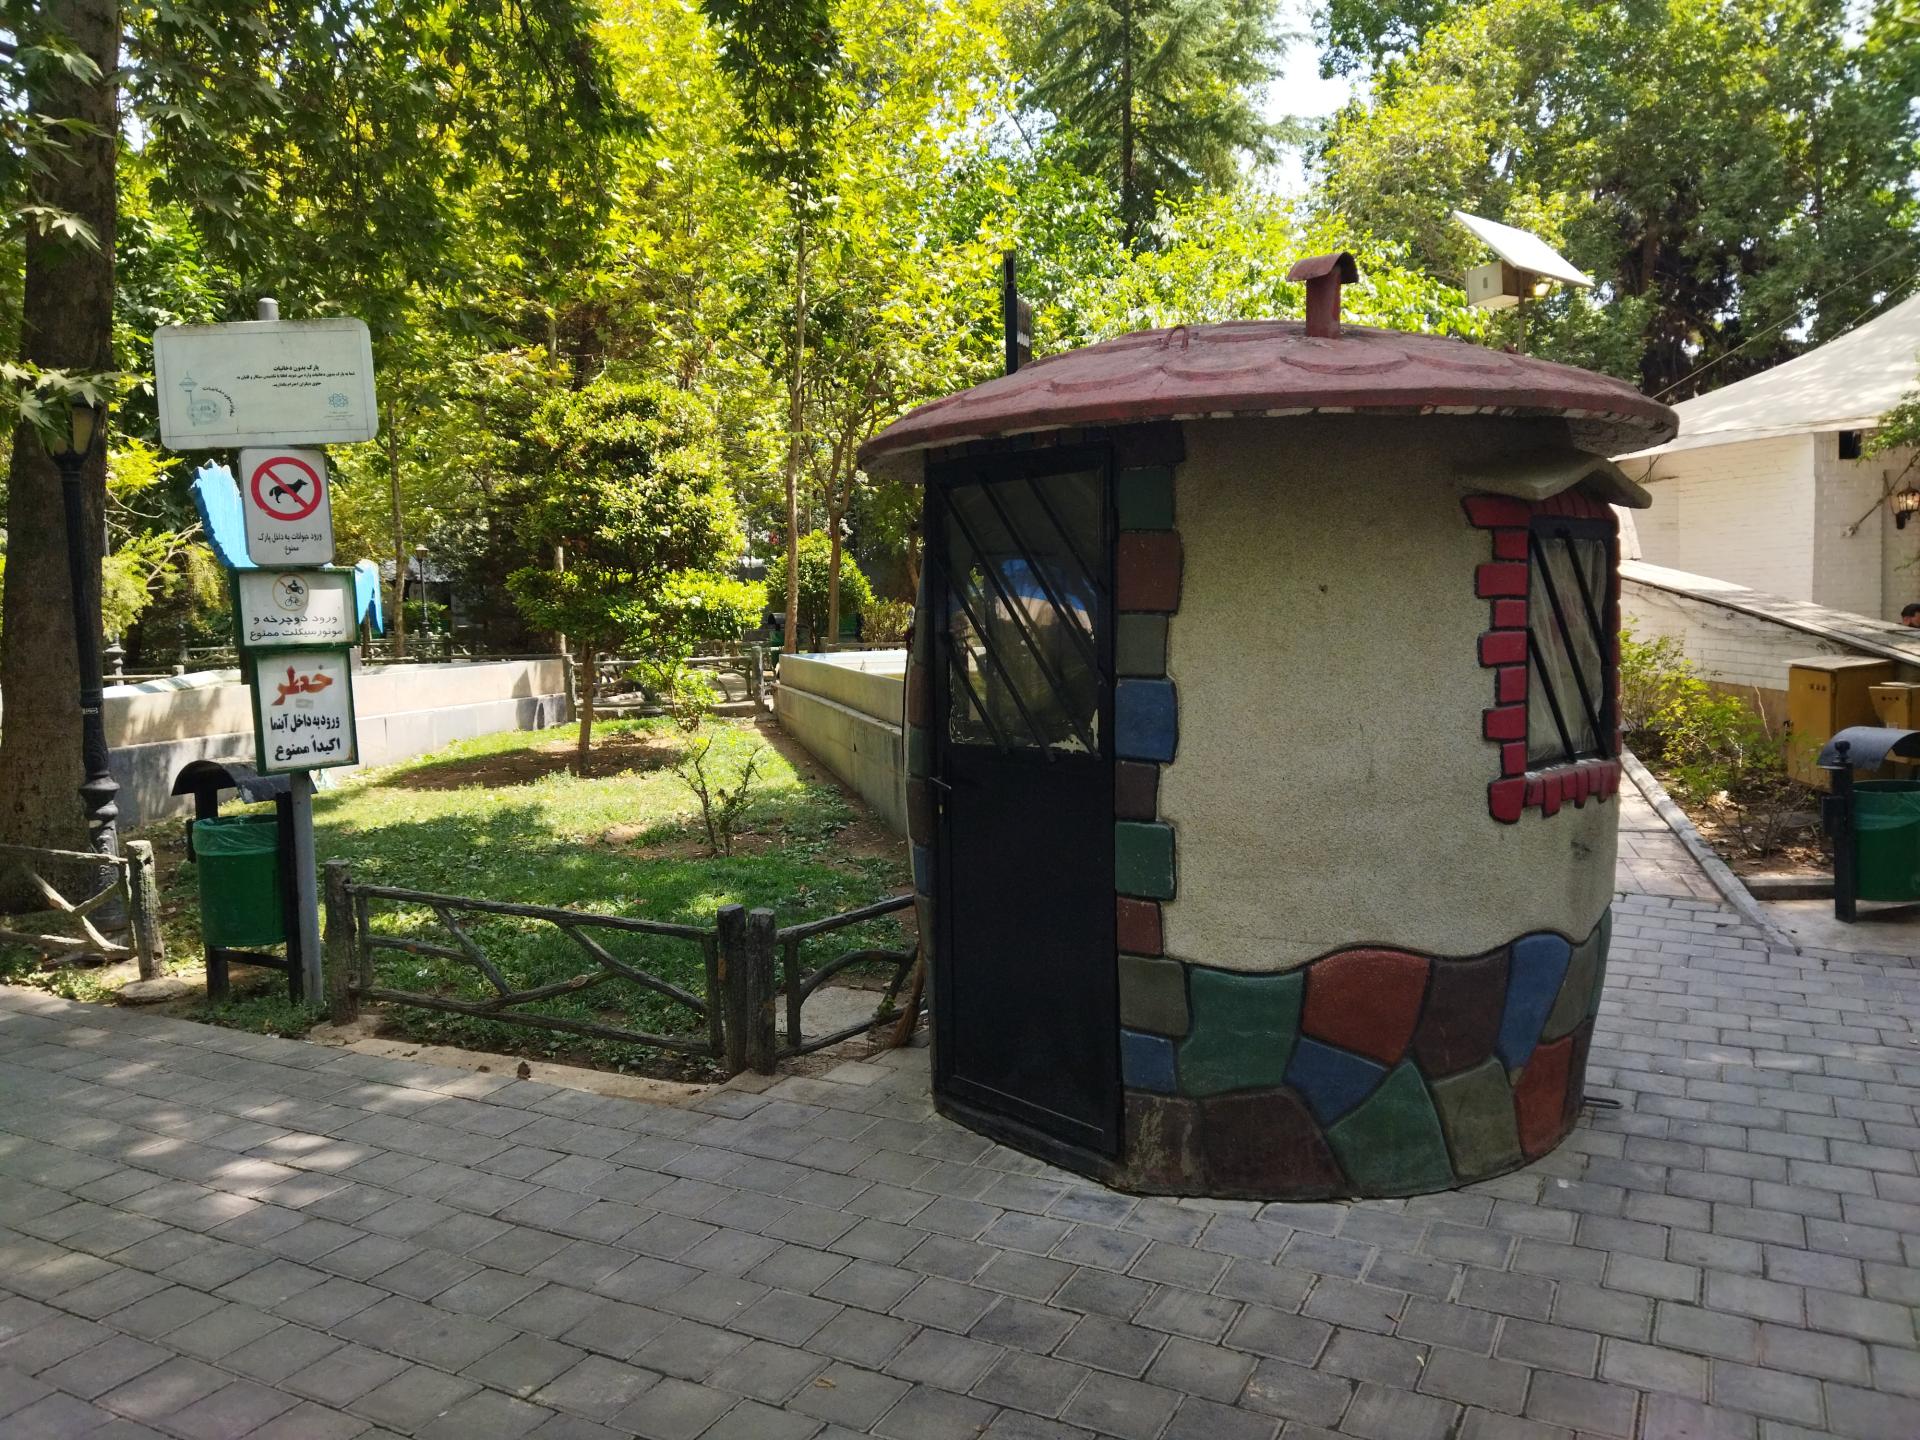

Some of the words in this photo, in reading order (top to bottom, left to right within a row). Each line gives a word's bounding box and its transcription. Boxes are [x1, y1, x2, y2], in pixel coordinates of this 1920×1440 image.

[258, 532, 271, 544] پارک
[272, 532, 284, 543] داخل
[284, 533, 290, 542] به
[291, 532, 310, 542] حیوانات
[311, 532, 322, 542] ورود
[284, 545, 300, 556] ممنوع
[254, 616, 260, 624] و
[262, 615, 308, 626] دوچرخه
[311, 616, 338, 624] ورود
[250, 629, 280, 641] ممنوع
[271, 664, 334, 706] خطر
[270, 713, 289, 734] آبنما
[290, 713, 312, 732] داخل
[312, 716, 320, 730] به
[320, 715, 340, 730] ورود
[274, 744, 310, 762] ممنوع
